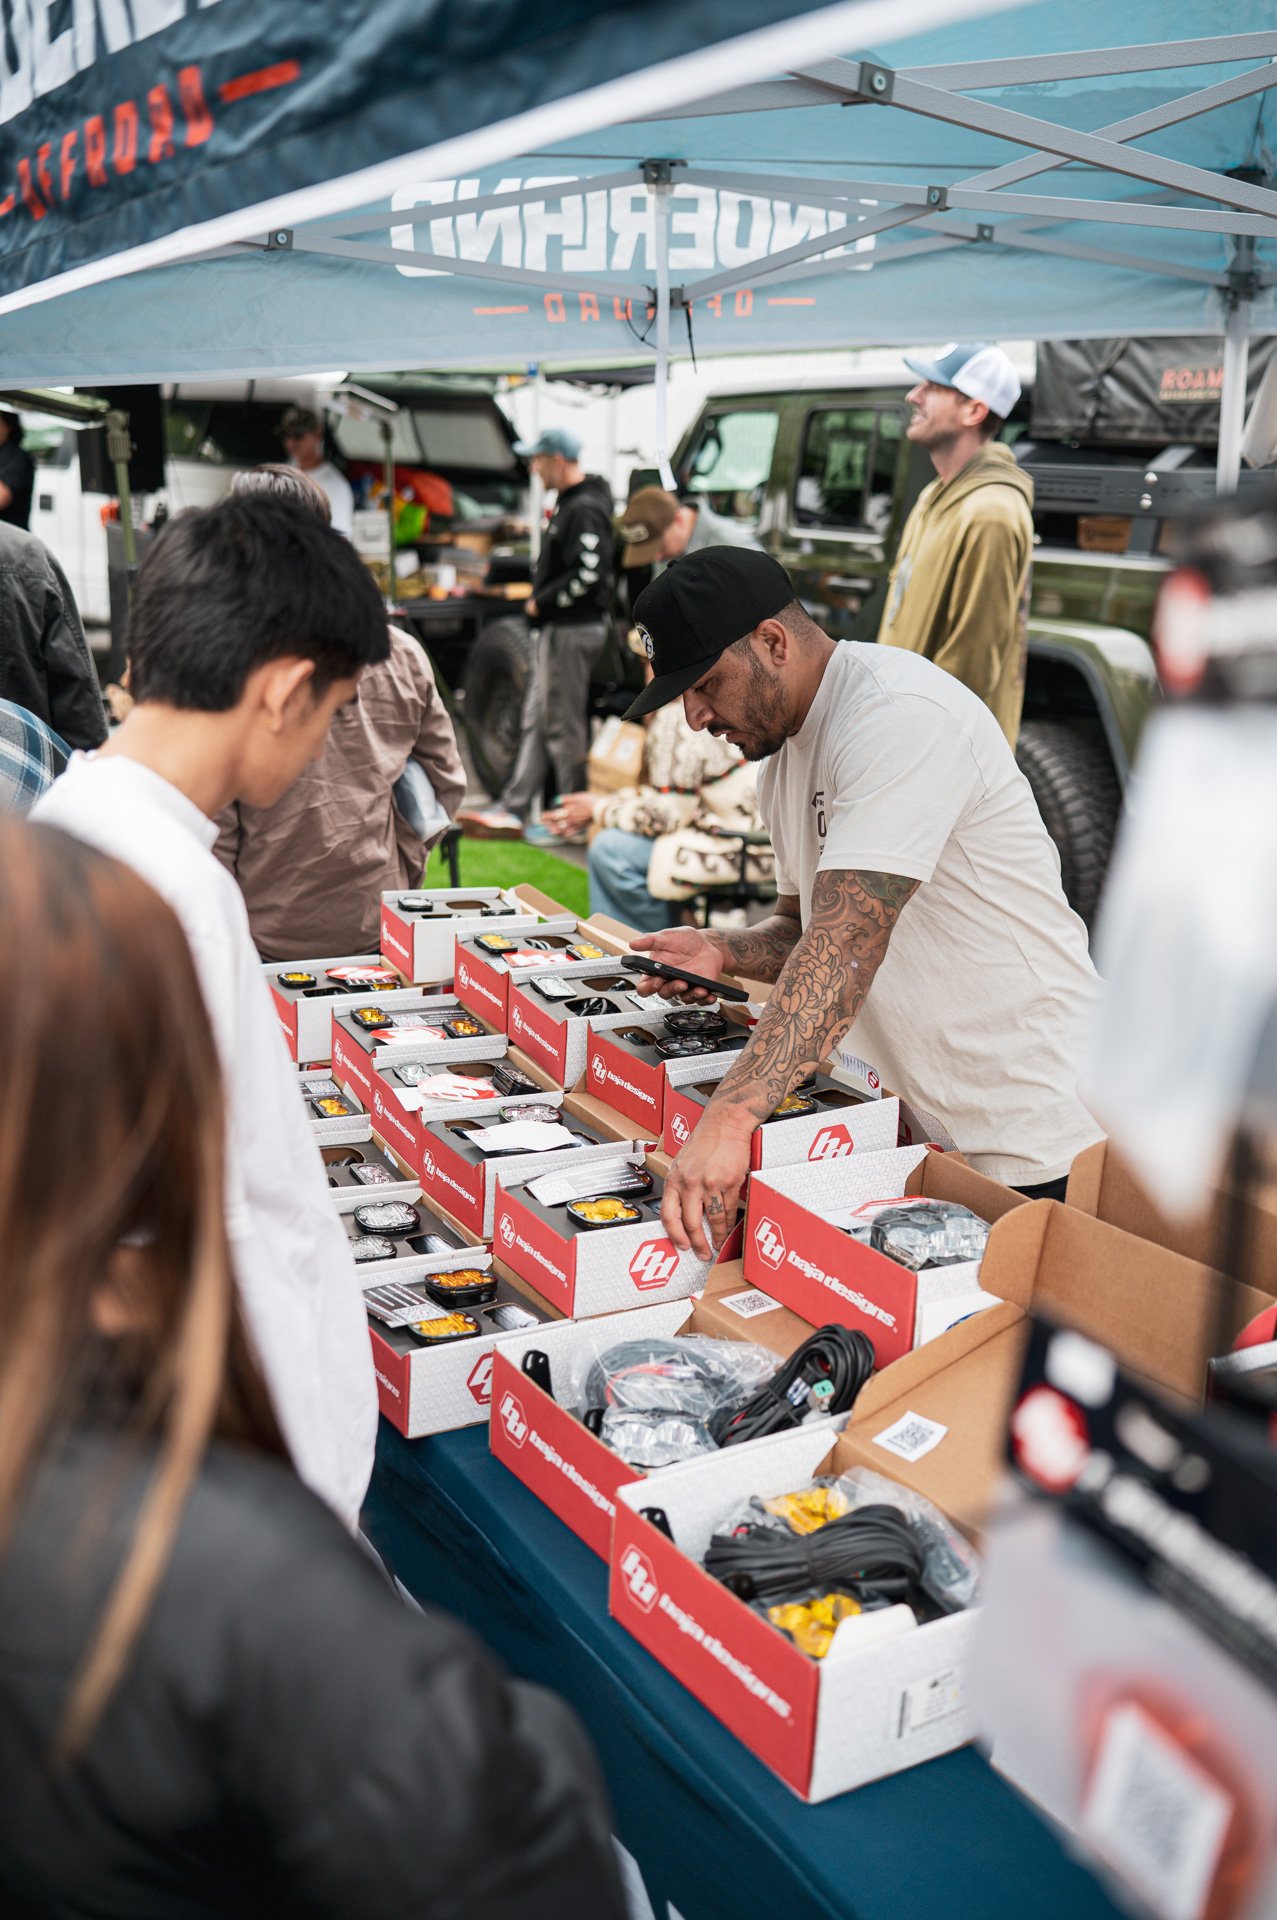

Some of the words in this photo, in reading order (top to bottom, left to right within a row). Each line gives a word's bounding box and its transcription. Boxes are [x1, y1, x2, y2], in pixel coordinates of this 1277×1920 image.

[533, 1248, 567, 1282] designs
[786, 1250, 825, 1283] baja
[823, 1275, 897, 1327] designs
[561, 1461, 616, 1518] design
